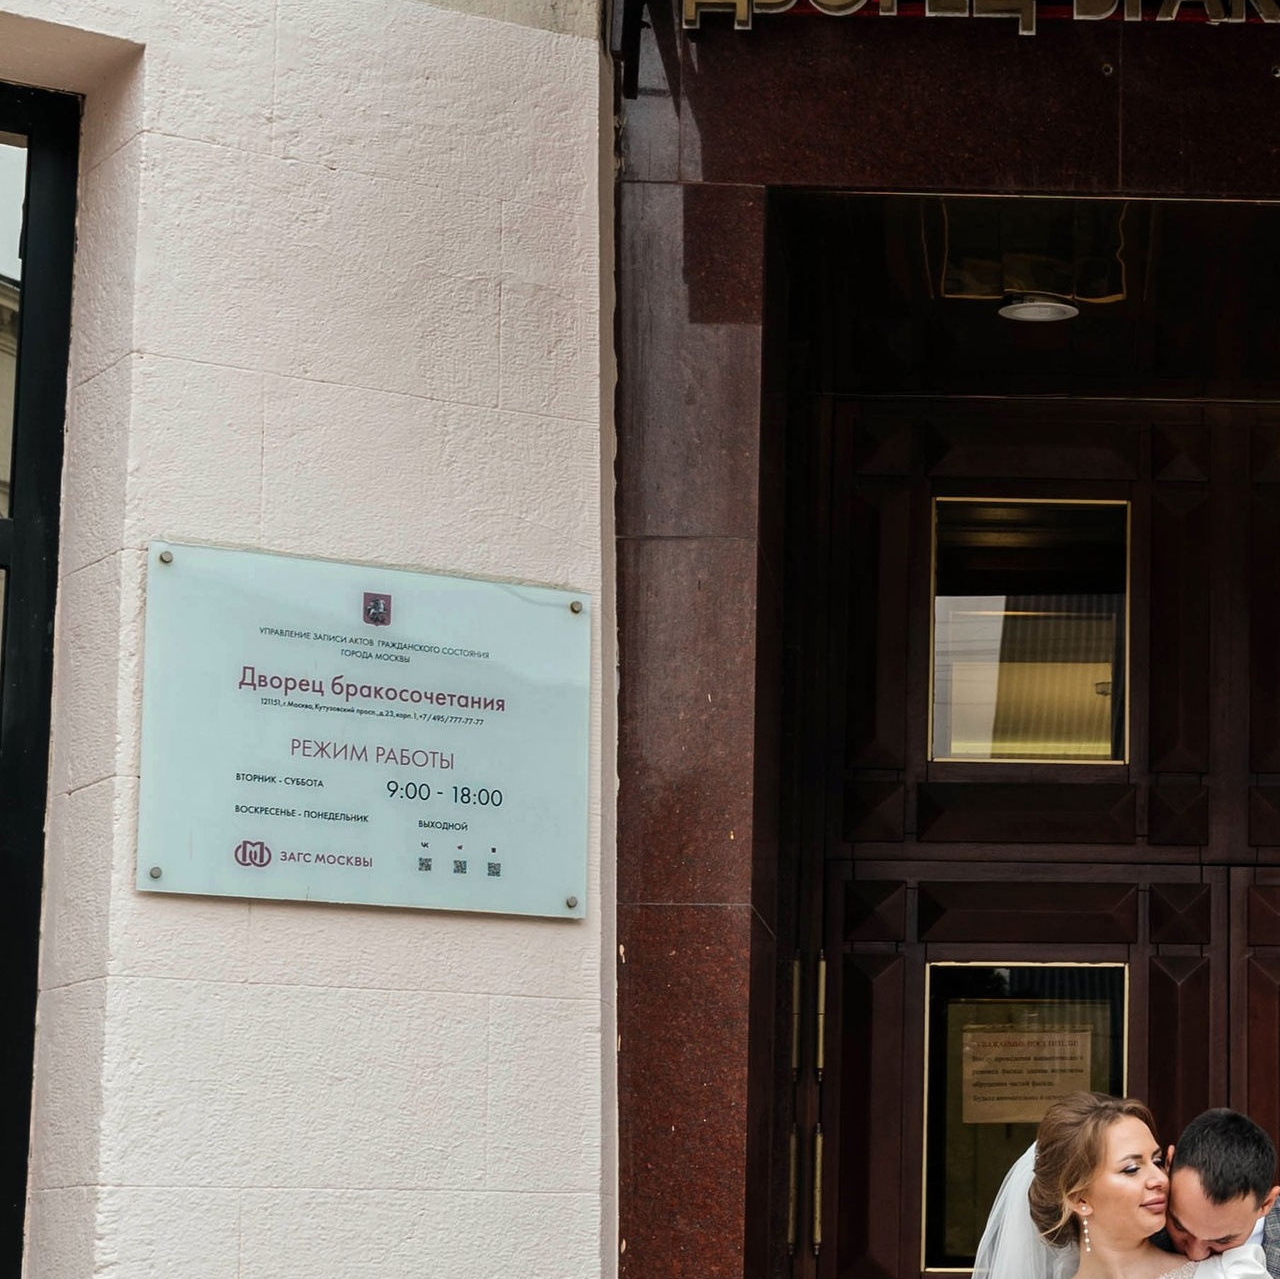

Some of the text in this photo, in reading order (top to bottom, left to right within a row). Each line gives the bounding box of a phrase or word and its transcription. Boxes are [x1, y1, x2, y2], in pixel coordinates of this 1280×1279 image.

[259, 627, 490, 659] УПРАВЛЕНИЕ ЗАПИСИ АКТОВ ГРАЖДАНСКОГО СОСТОЯНИЯ
[341, 648, 411, 663] ГОРОДА МОСКВЫ
[238, 665, 506, 712] Дворец бракосочетания
[291, 738, 455, 770] РЕЖИМ РАБОТЫ
[235, 772, 277, 784] ВТОРНИК
[283, 776, 324, 788] СУББОТА
[386, 780, 431, 801] 9:00
[451, 785, 503, 807] 18:00
[234, 805, 297, 818] ВОСКРЕСЕНЬЕ
[303, 810, 369, 823] ПОНЕДЕЛЬНИК
[418, 818, 468, 831] ВЫХОДНОЙ
[280, 851, 373, 868] ЗАГС МОСКВЫ
